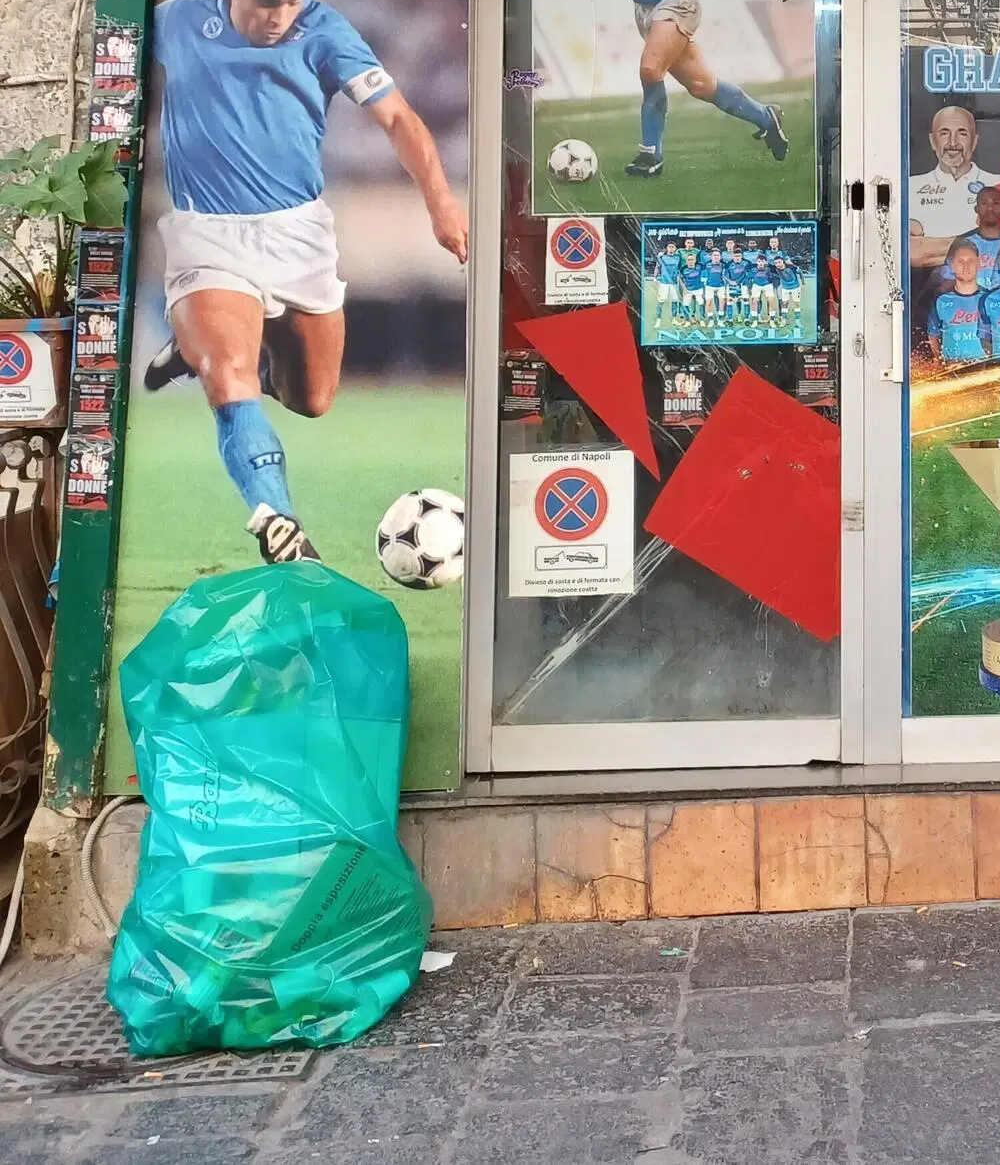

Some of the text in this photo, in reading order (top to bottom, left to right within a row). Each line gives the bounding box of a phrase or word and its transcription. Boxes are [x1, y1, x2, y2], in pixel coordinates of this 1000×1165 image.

[96, 43, 136, 56] SP
[95, 63, 135, 75] DONNE
[92, 112, 133, 125] SP
[90, 132, 131, 146] DONE
[78, 322, 117, 335] SP
[655, 327, 805, 342] NAPOLI
[77, 341, 117, 354] DONNE
[664, 378, 703, 392] SP
[664, 398, 703, 411] DONNE
[532, 452, 611, 462] Comune di Napoli
[70, 459, 109, 474] SP
[68, 479, 108, 494] DONNE
[291, 844, 369, 953] Doppia esposizione
